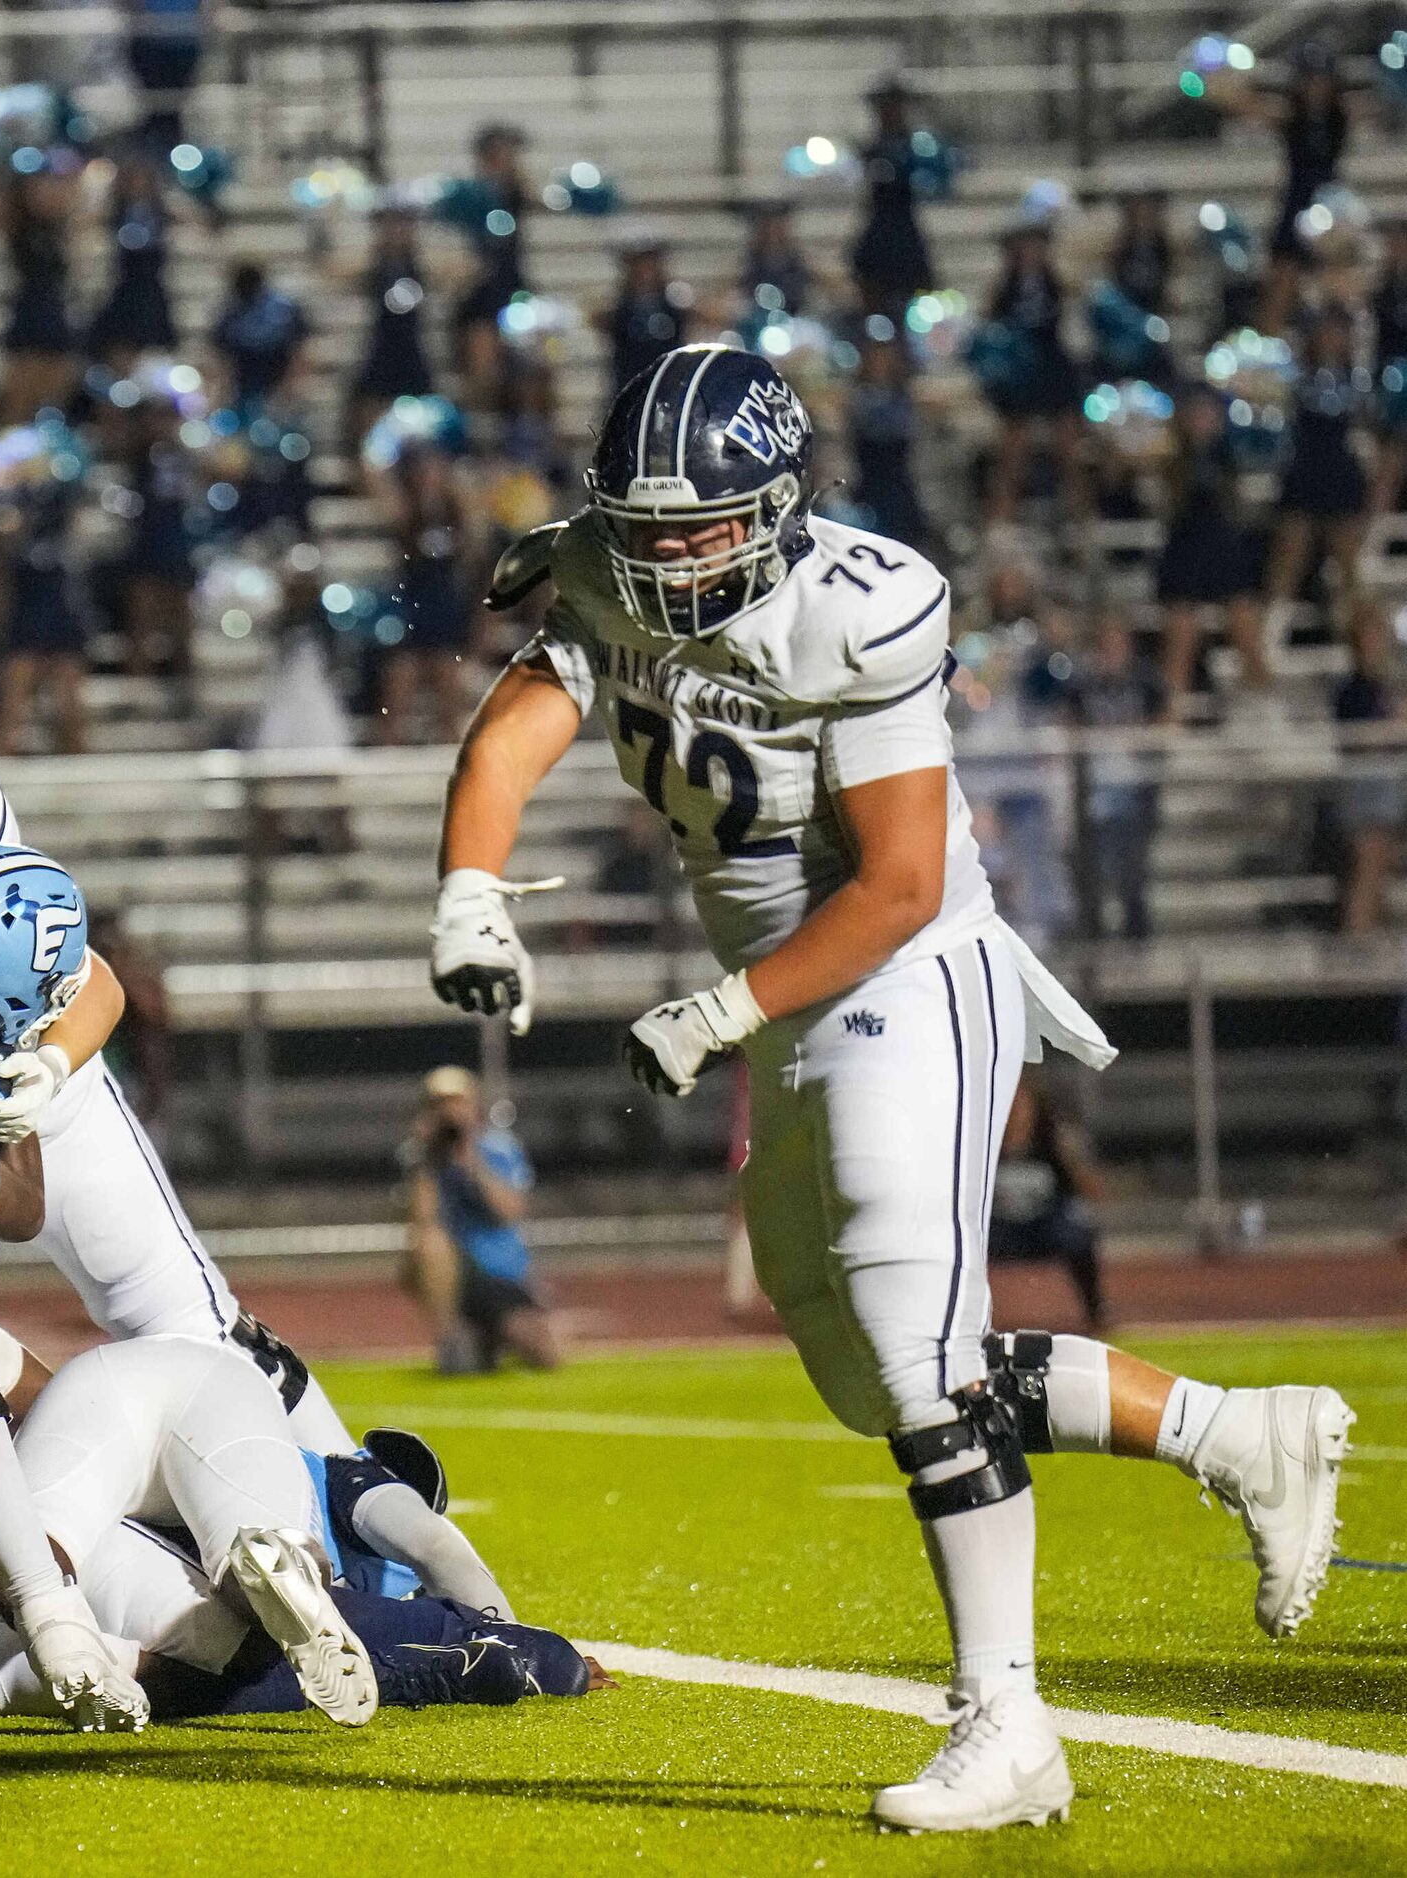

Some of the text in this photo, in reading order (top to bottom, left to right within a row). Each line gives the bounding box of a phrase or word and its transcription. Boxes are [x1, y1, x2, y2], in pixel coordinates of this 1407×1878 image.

[634, 480, 684, 491] THE GROVE
[818, 543, 908, 594] 72
[616, 696, 800, 858] 72
